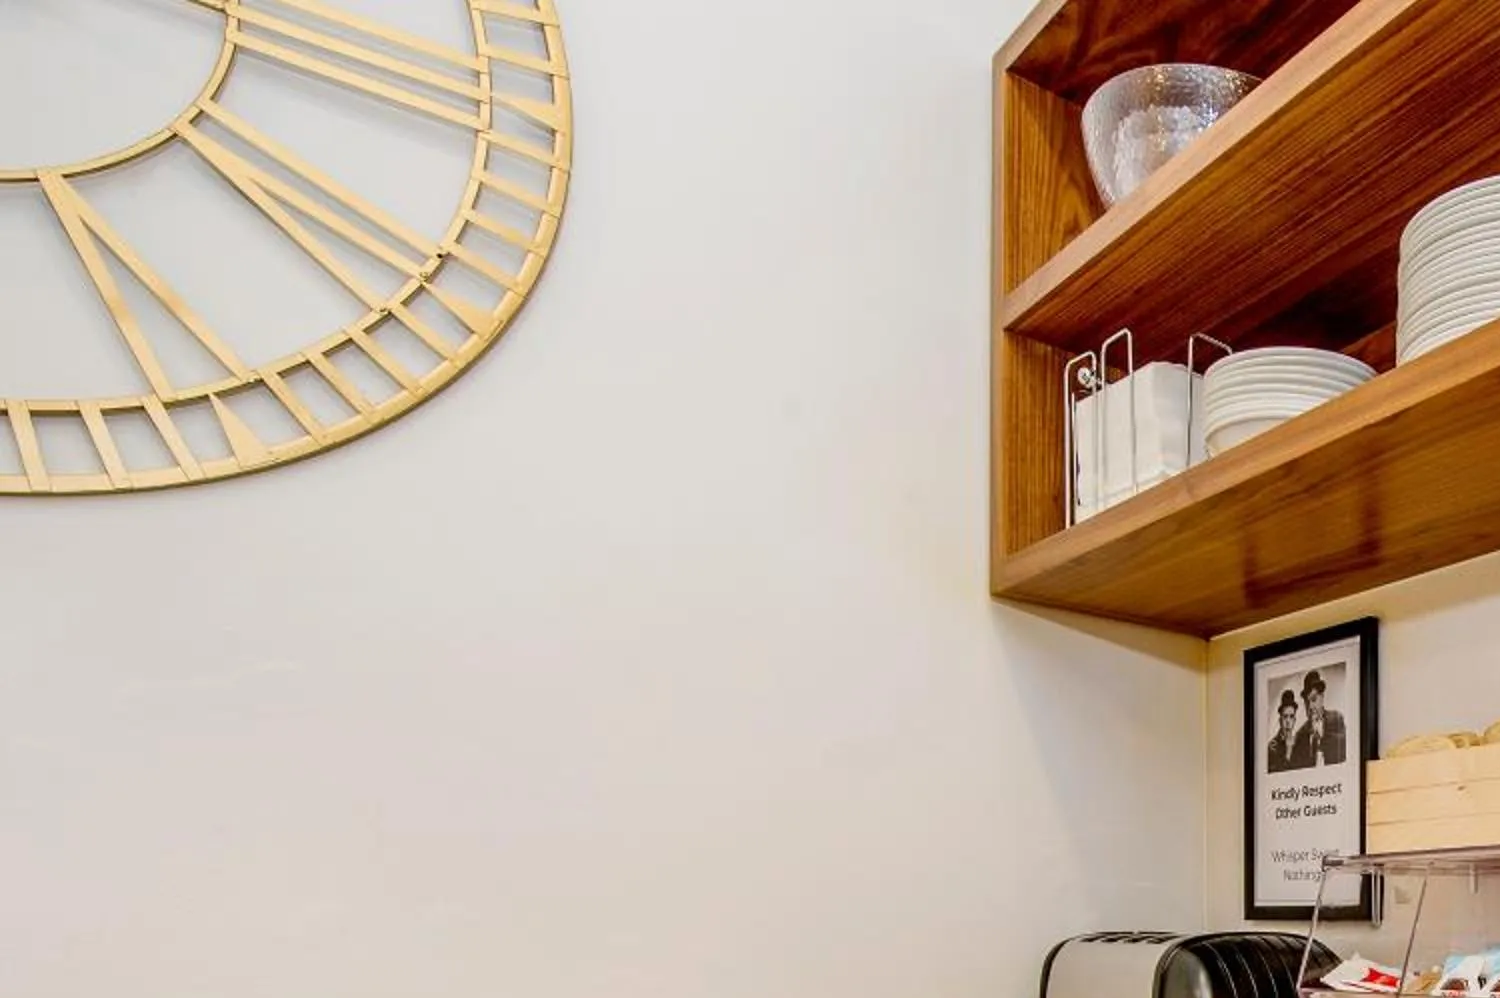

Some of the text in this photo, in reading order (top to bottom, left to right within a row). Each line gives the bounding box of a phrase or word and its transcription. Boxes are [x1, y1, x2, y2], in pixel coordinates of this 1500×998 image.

[1271, 783, 1343, 801] Kindly Respect
[1275, 803, 1337, 820] Other Guests
[1283, 869, 1322, 883] Nothing
